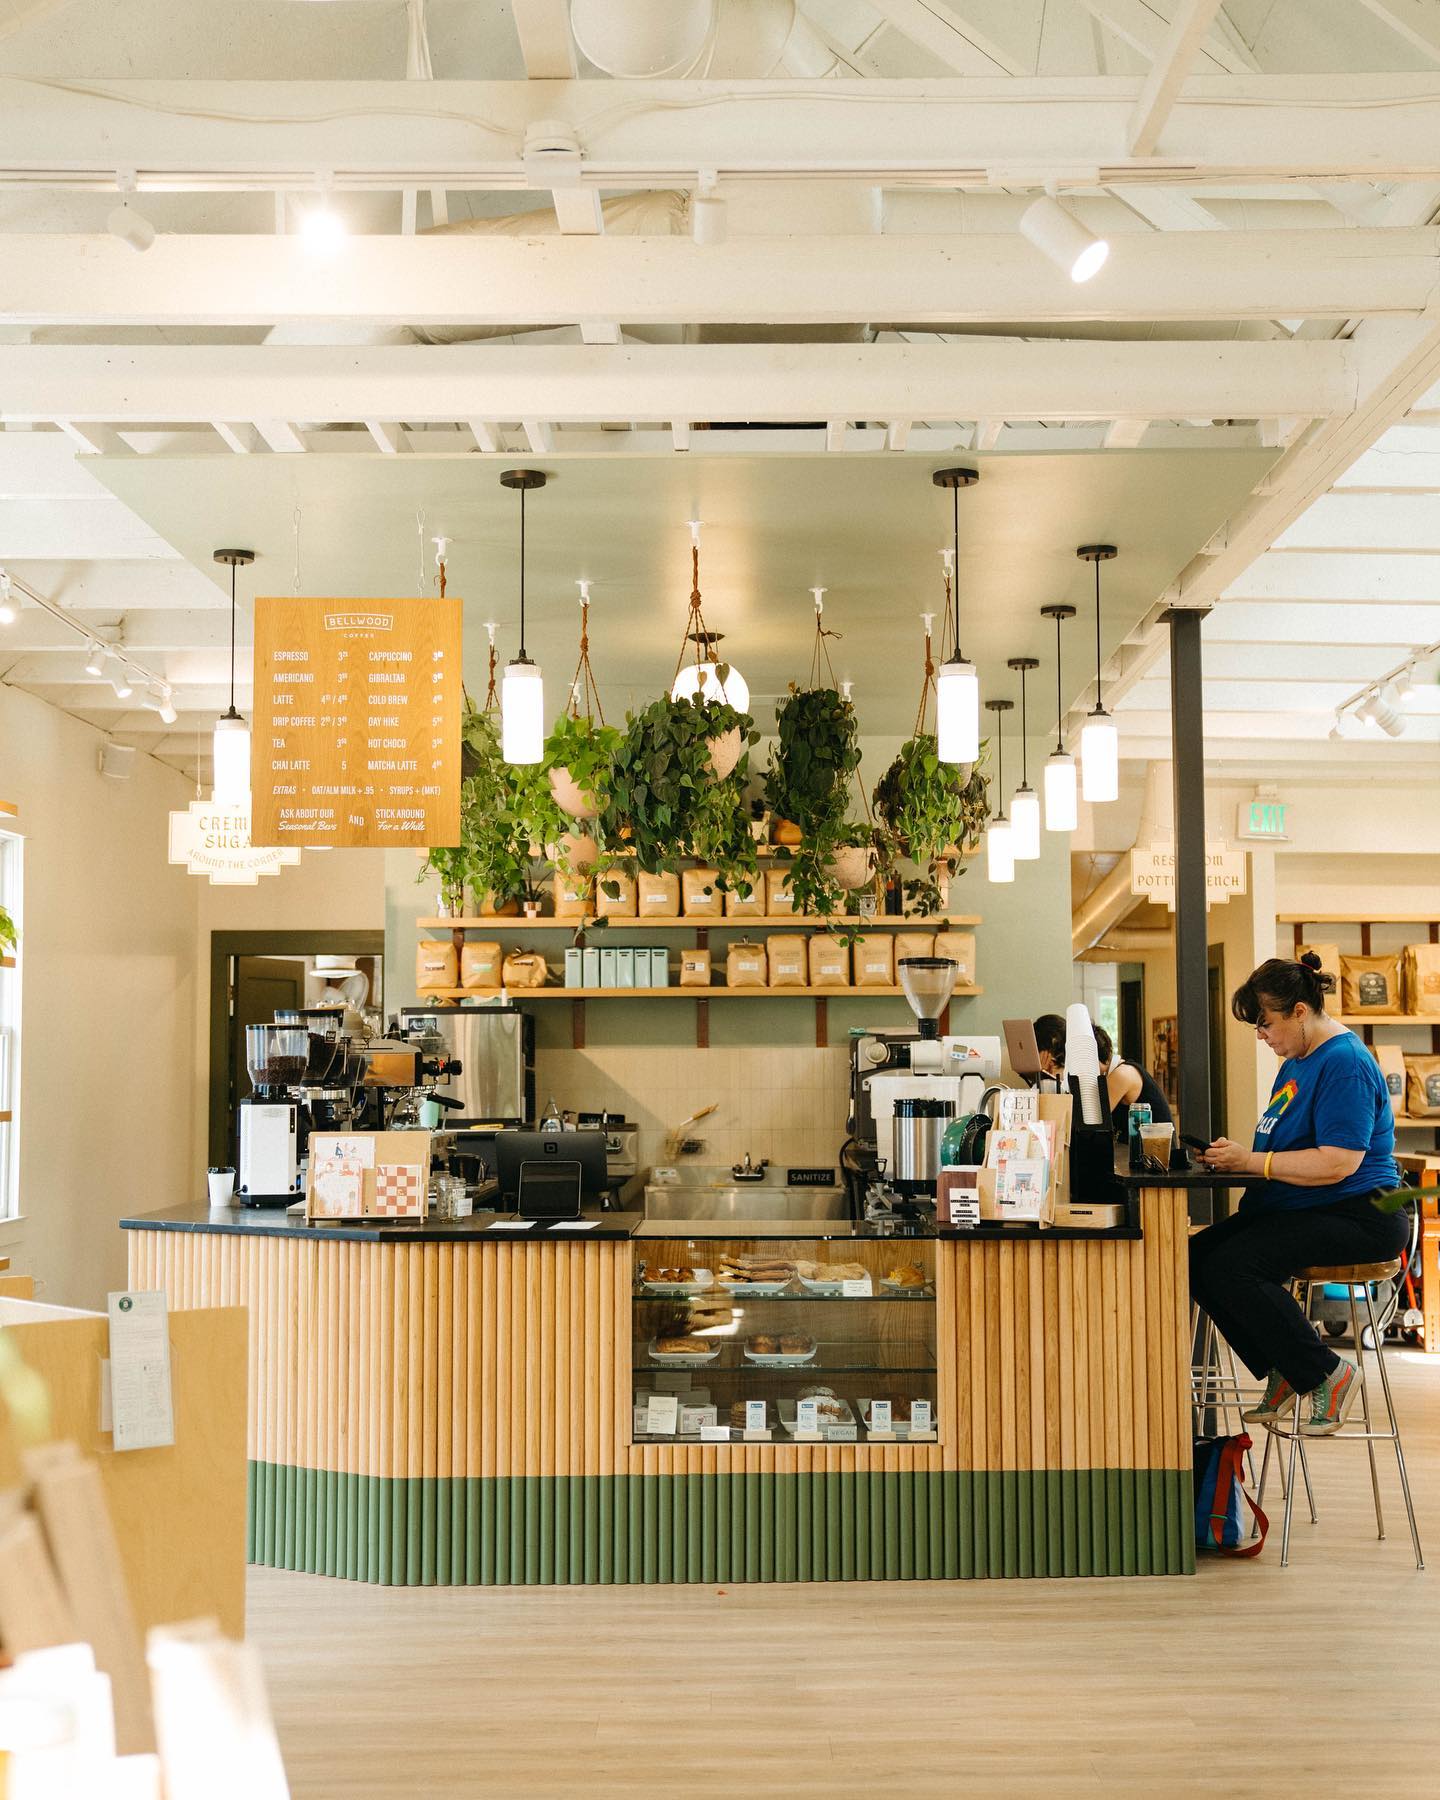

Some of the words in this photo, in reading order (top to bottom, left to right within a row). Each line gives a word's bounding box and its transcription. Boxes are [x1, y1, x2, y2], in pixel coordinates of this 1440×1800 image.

[329, 617, 389, 627] BELLWOOD
[273, 652, 308, 662] ESPRESSO
[368, 652, 412, 662] CAPPUCCINO
[273, 673, 314, 683] AMERICANO
[368, 673, 406, 684] GIBRALTAR
[273, 695, 294, 705] LATTE
[368, 695, 387, 705] COLD
[388, 695, 408, 705] BREW
[272, 716, 289, 726] DRIP
[290, 716, 316, 726] COFFEE
[368, 716, 382, 726] DAY
[384, 716, 399, 726] HIKE
[272, 738, 286, 748] TEA
[368, 738, 381, 748] HOT
[383, 738, 406, 748] CHOCO
[272, 760, 288, 770] CHAI
[290, 760, 310, 770] LATTE
[342, 760, 346, 770] 5
[368, 760, 395, 770] MATCHA
[398, 760, 417, 770] LATTE
[272, 786, 296, 794] EXTRAS
[312, 786, 340, 794] OAT/ALM
[340, 786, 356, 794] MILK
[390, 786, 414, 795] SYRUPS
[280, 808, 294, 818] ASK
[296, 808, 318, 818] ABOUT
[320, 808, 334, 818] OUR
[376, 808, 396, 818] STICK
[396, 808, 425, 818] AROUND
[1249, 803, 1286, 832] EXIT
[349, 814, 364, 826] AND
[278, 821, 316, 831] Seasonal
[376, 821, 392, 831] For
[401, 821, 426, 831] While
[186, 849, 224, 869] AROUND
[228, 860, 244, 869] THE
[248, 849, 285, 869] CORNER
[791, 1173, 832, 1182] SANITIZE
